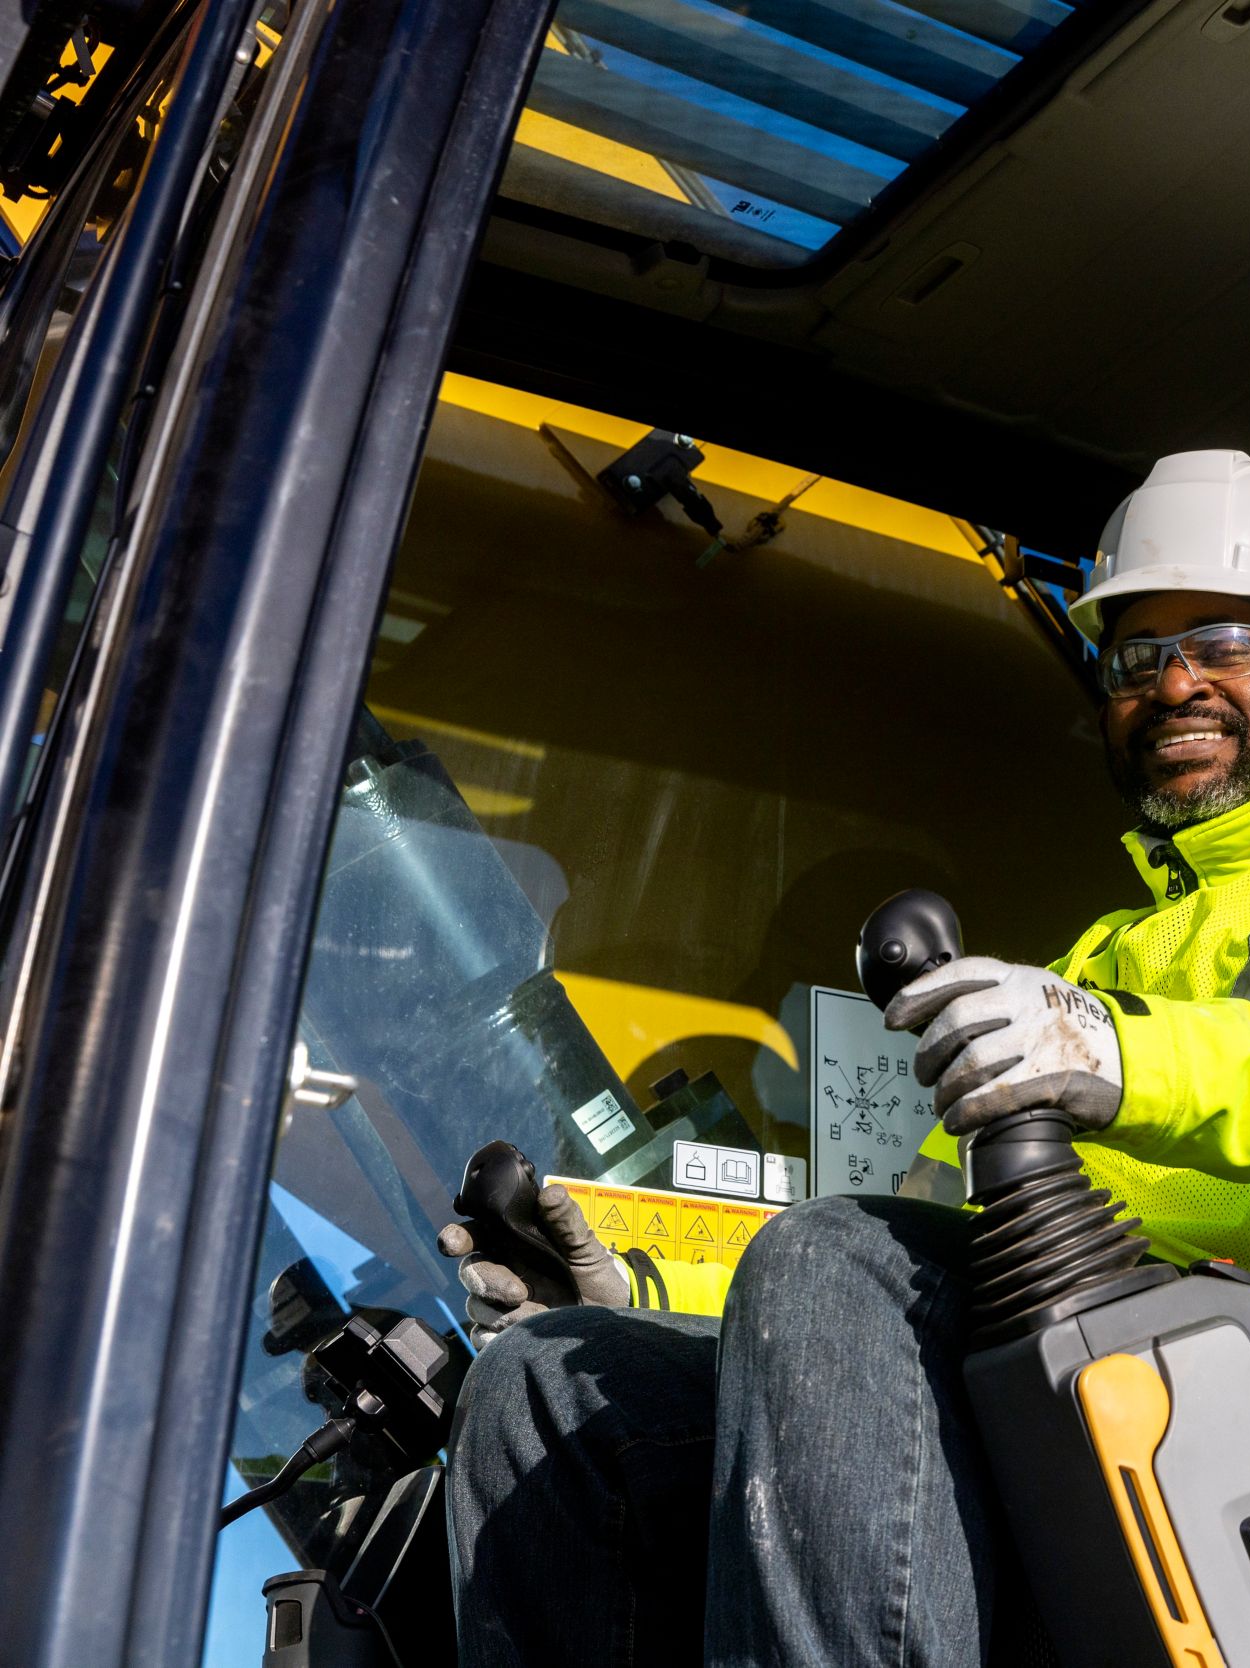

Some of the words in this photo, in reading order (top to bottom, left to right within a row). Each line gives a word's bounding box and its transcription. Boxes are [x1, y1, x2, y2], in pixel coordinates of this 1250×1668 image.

[603, 1191, 632, 1201] WARNING
[646, 1197, 674, 1206] WARNING
[689, 1203, 716, 1212] WARNING
[731, 1208, 757, 1217] WARNING
